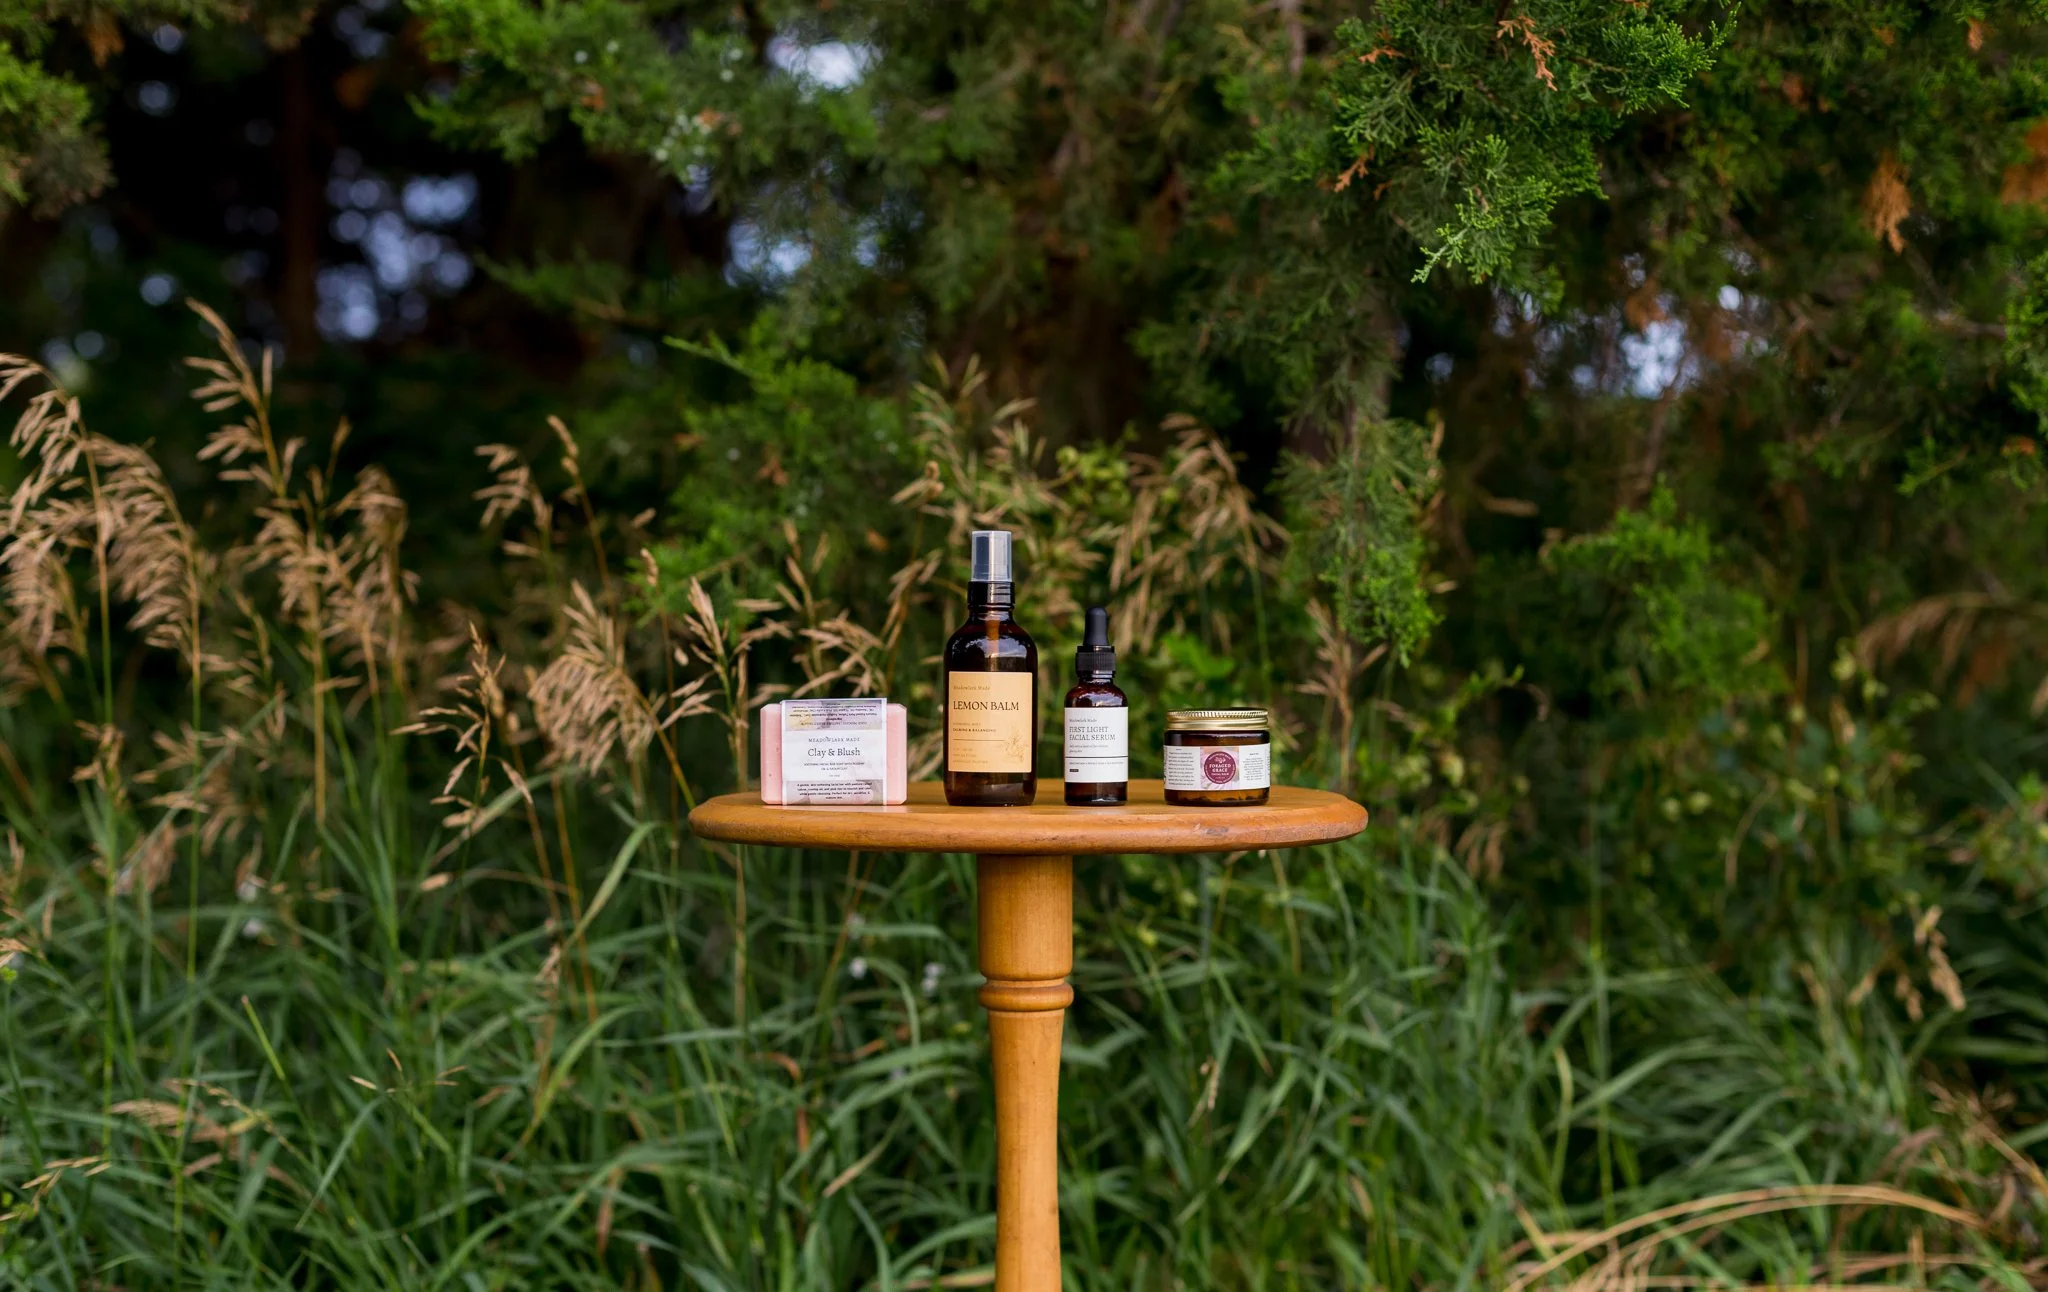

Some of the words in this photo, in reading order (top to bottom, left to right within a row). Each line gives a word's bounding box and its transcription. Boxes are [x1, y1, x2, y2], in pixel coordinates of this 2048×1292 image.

[953, 701, 988, 710] LEMON
[991, 701, 1019, 711] BALM
[807, 748, 826, 758] Clay
[828, 749, 835, 757] &
[837, 747, 860, 757] Blush
